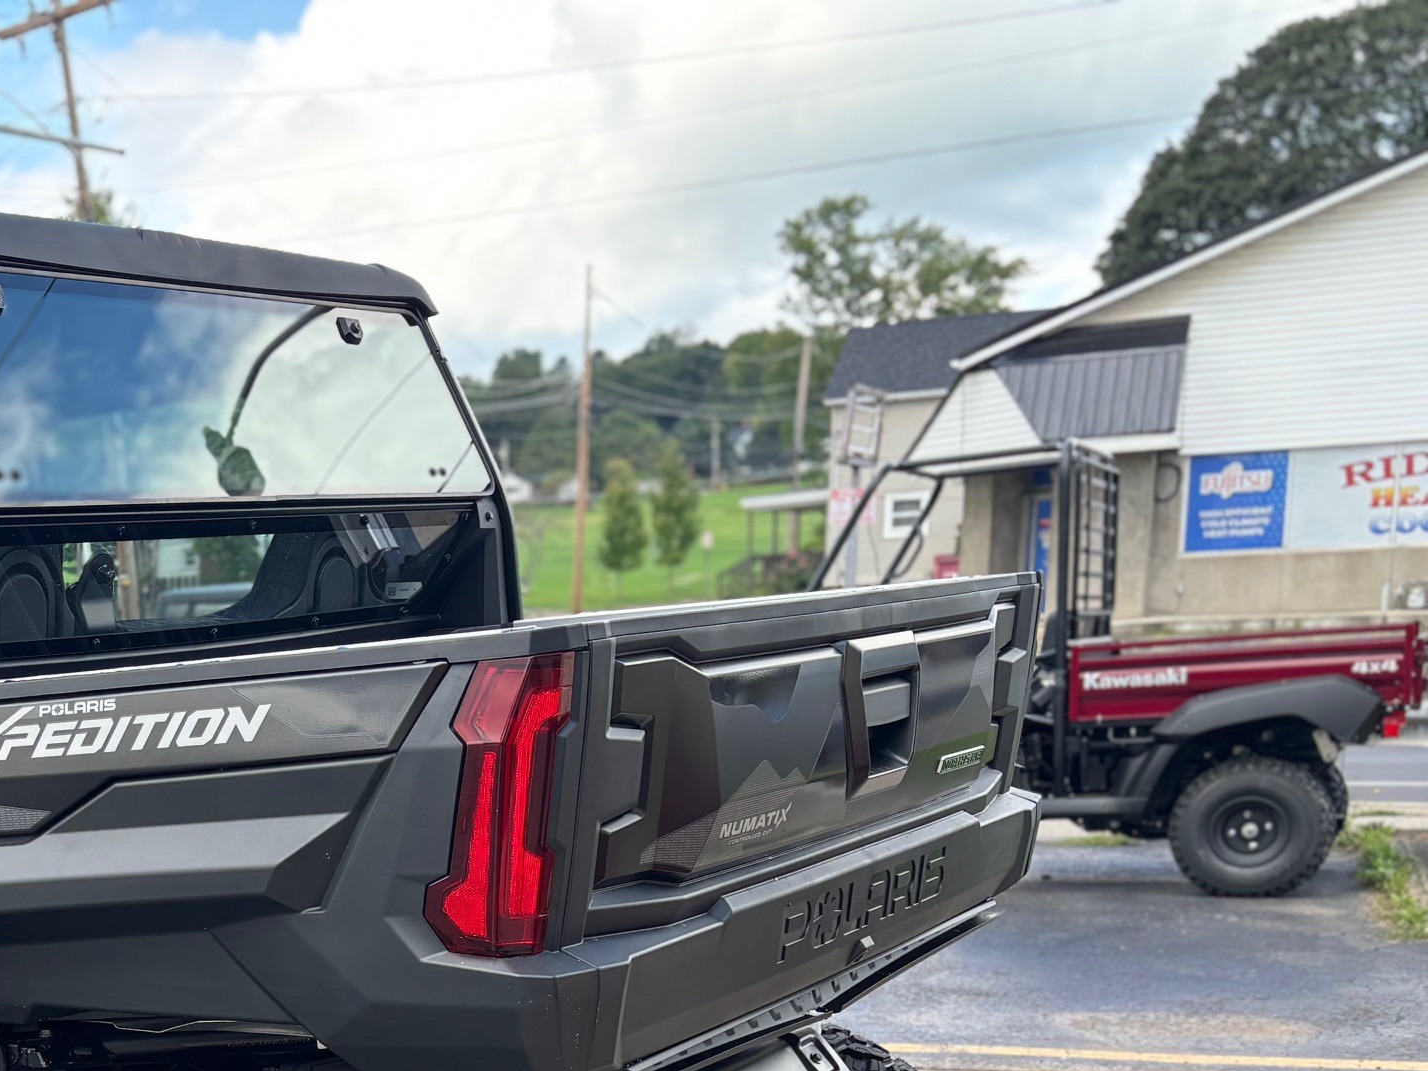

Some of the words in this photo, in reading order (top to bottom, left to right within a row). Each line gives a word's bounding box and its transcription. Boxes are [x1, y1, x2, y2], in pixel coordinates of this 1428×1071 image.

[1083, 667, 1188, 690] Kawasaki
[39, 699, 116, 717] POLARIS
[719, 802, 792, 839] NUMATIX
[776, 846, 947, 964] POLARIS
